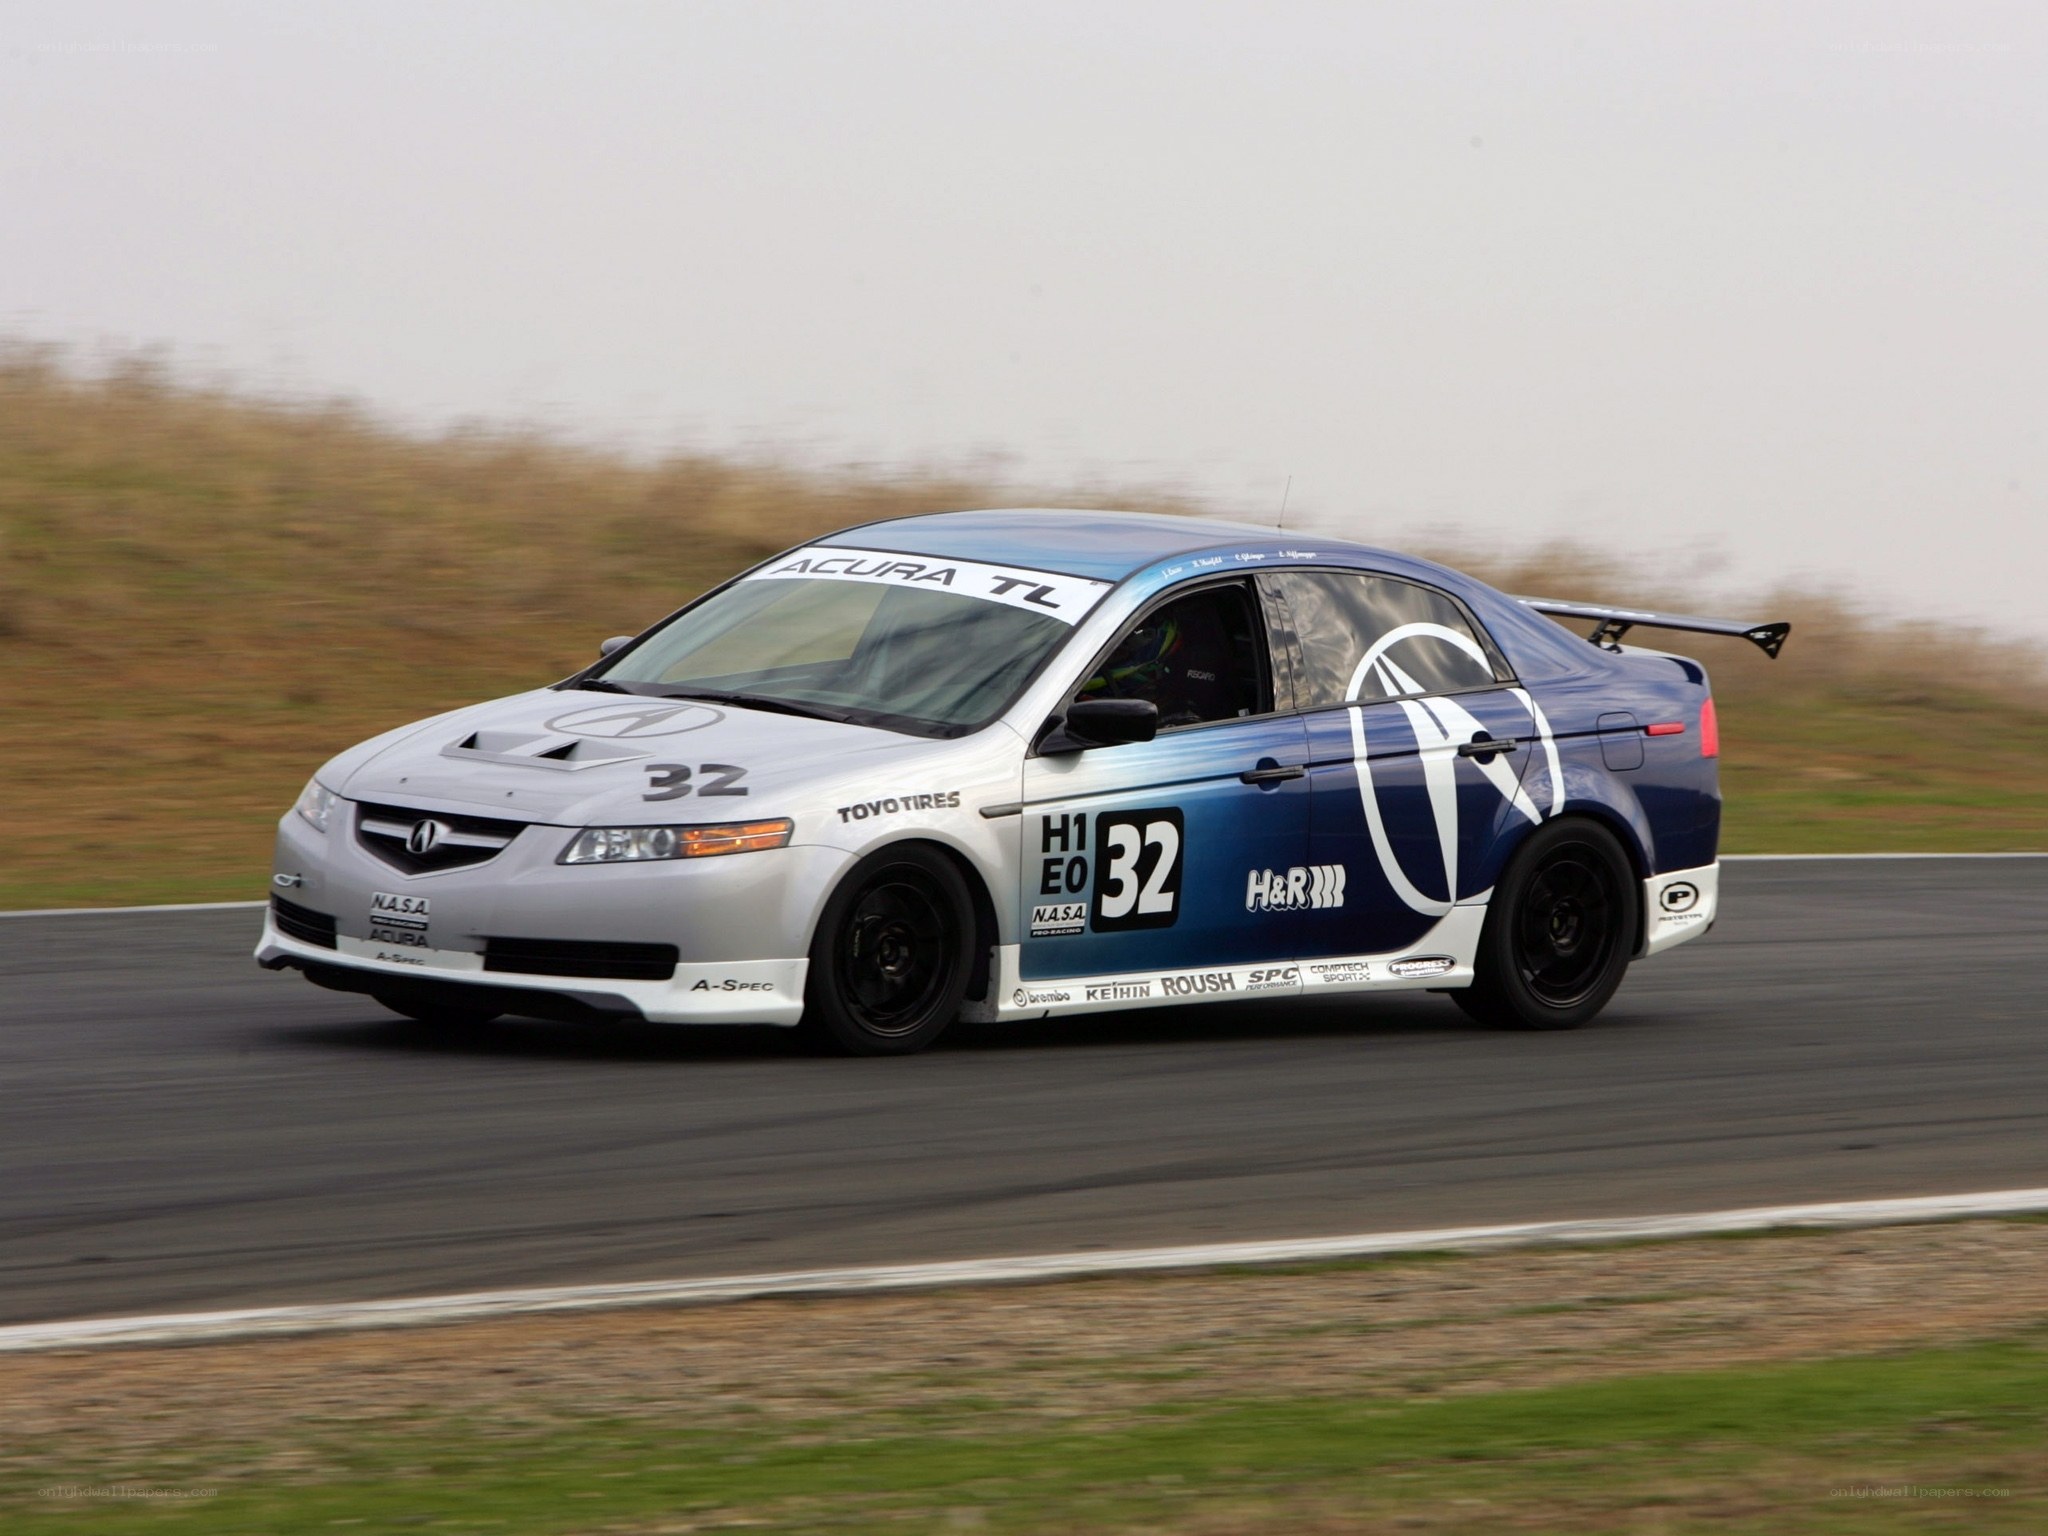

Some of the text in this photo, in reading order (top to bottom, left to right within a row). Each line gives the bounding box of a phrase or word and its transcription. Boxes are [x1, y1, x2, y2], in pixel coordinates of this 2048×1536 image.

[771, 558, 1062, 610] ACURA TL
[642, 763, 748, 802] 32
[1041, 812, 1087, 853] H1
[1100, 820, 1180, 919] 32
[1246, 867, 1311, 912] H&R
[369, 928, 429, 948] ACURA
[1310, 962, 1370, 975] COMPTECH
[1392, 958, 1451, 971] PROGRESS
[1161, 972, 1236, 996] ROUSH
[1247, 967, 1299, 984] SPC
[1323, 972, 1358, 983] SPORT
[1085, 982, 1150, 1001] KEIHIN
[1245, 980, 1298, 992] PERFORMANCE
[1028, 990, 1071, 1004] brembo
